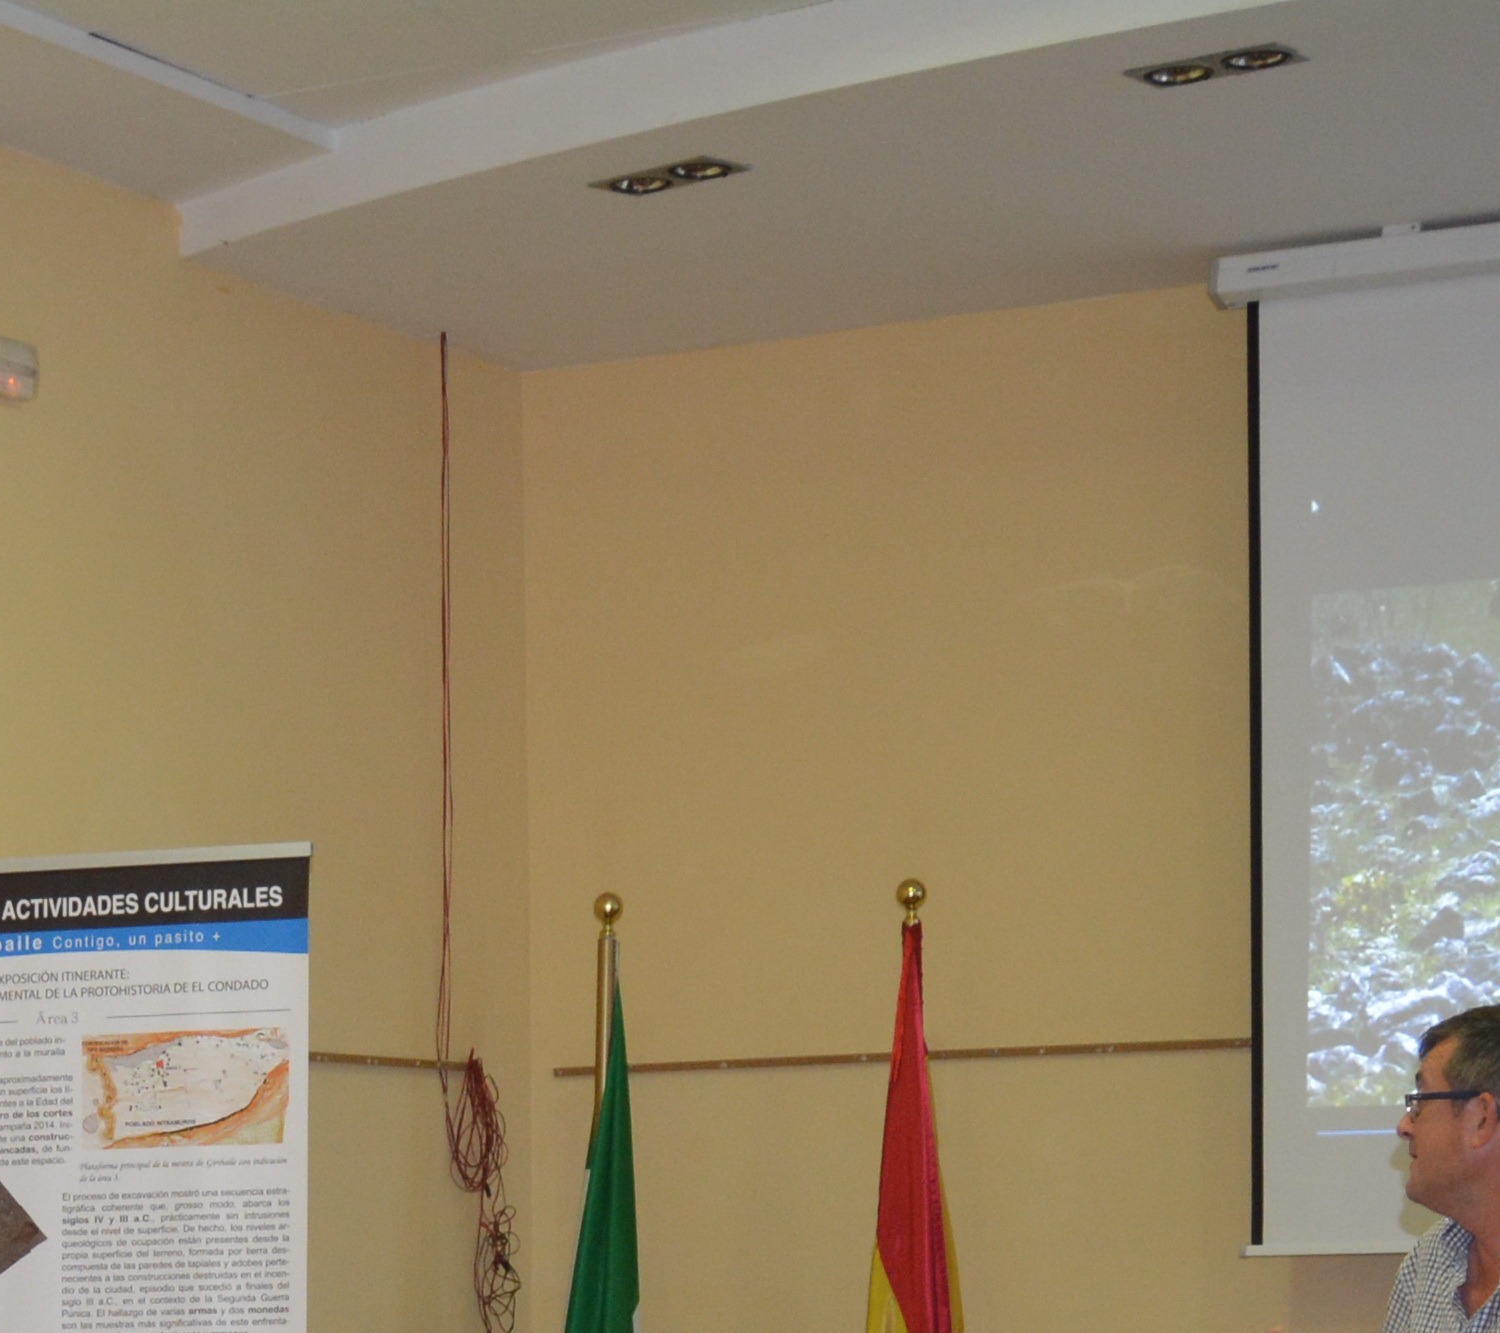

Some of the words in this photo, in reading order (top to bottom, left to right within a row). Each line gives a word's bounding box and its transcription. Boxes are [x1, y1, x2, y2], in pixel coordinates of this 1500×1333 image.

[1, 893, 139, 920] ACTIVIDADES
[144, 886, 283, 912] CULTURALES
[52, 934, 120, 951] Contigo,
[128, 935, 146, 946] un
[155, 929, 204, 948] pasito
[61, 968, 129, 981] ITINERANTE:
[45, 987, 59, 999] DE
[63, 987, 78, 998] LA
[80, 983, 171, 997] PROTOHISTORIA
[173, 981, 187, 994] DE
[191, 981, 204, 992] EL
[207, 978, 269, 992] CONDADO
[71, 1011, 78, 1024] 3
